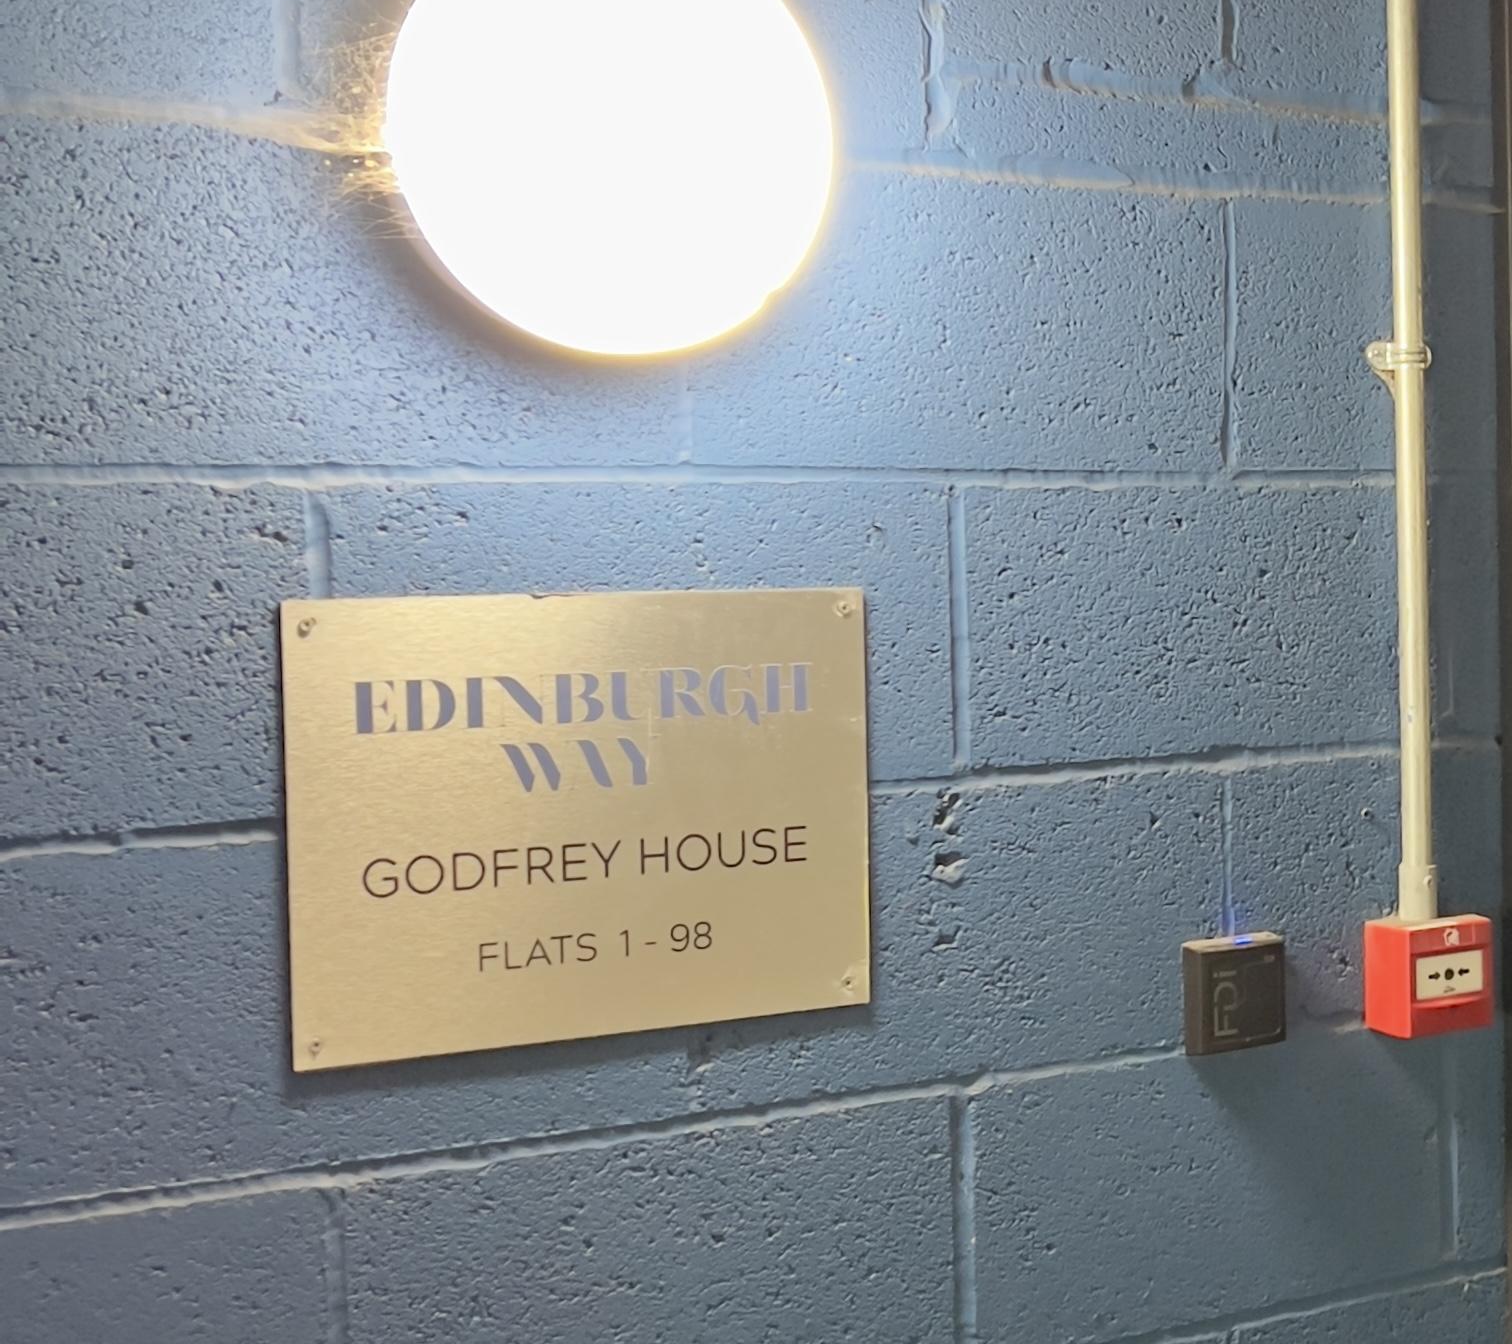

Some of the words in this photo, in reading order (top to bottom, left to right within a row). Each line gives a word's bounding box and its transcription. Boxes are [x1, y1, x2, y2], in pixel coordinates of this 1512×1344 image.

[354, 662, 812, 735] EDINBURGH
[499, 736, 654, 793] WAY
[362, 839, 622, 899] GODFREY
[639, 825, 808, 874] HOUSE
[477, 933, 598, 973] FLATS
[619, 929, 632, 958] 1
[669, 921, 714, 953] 98
